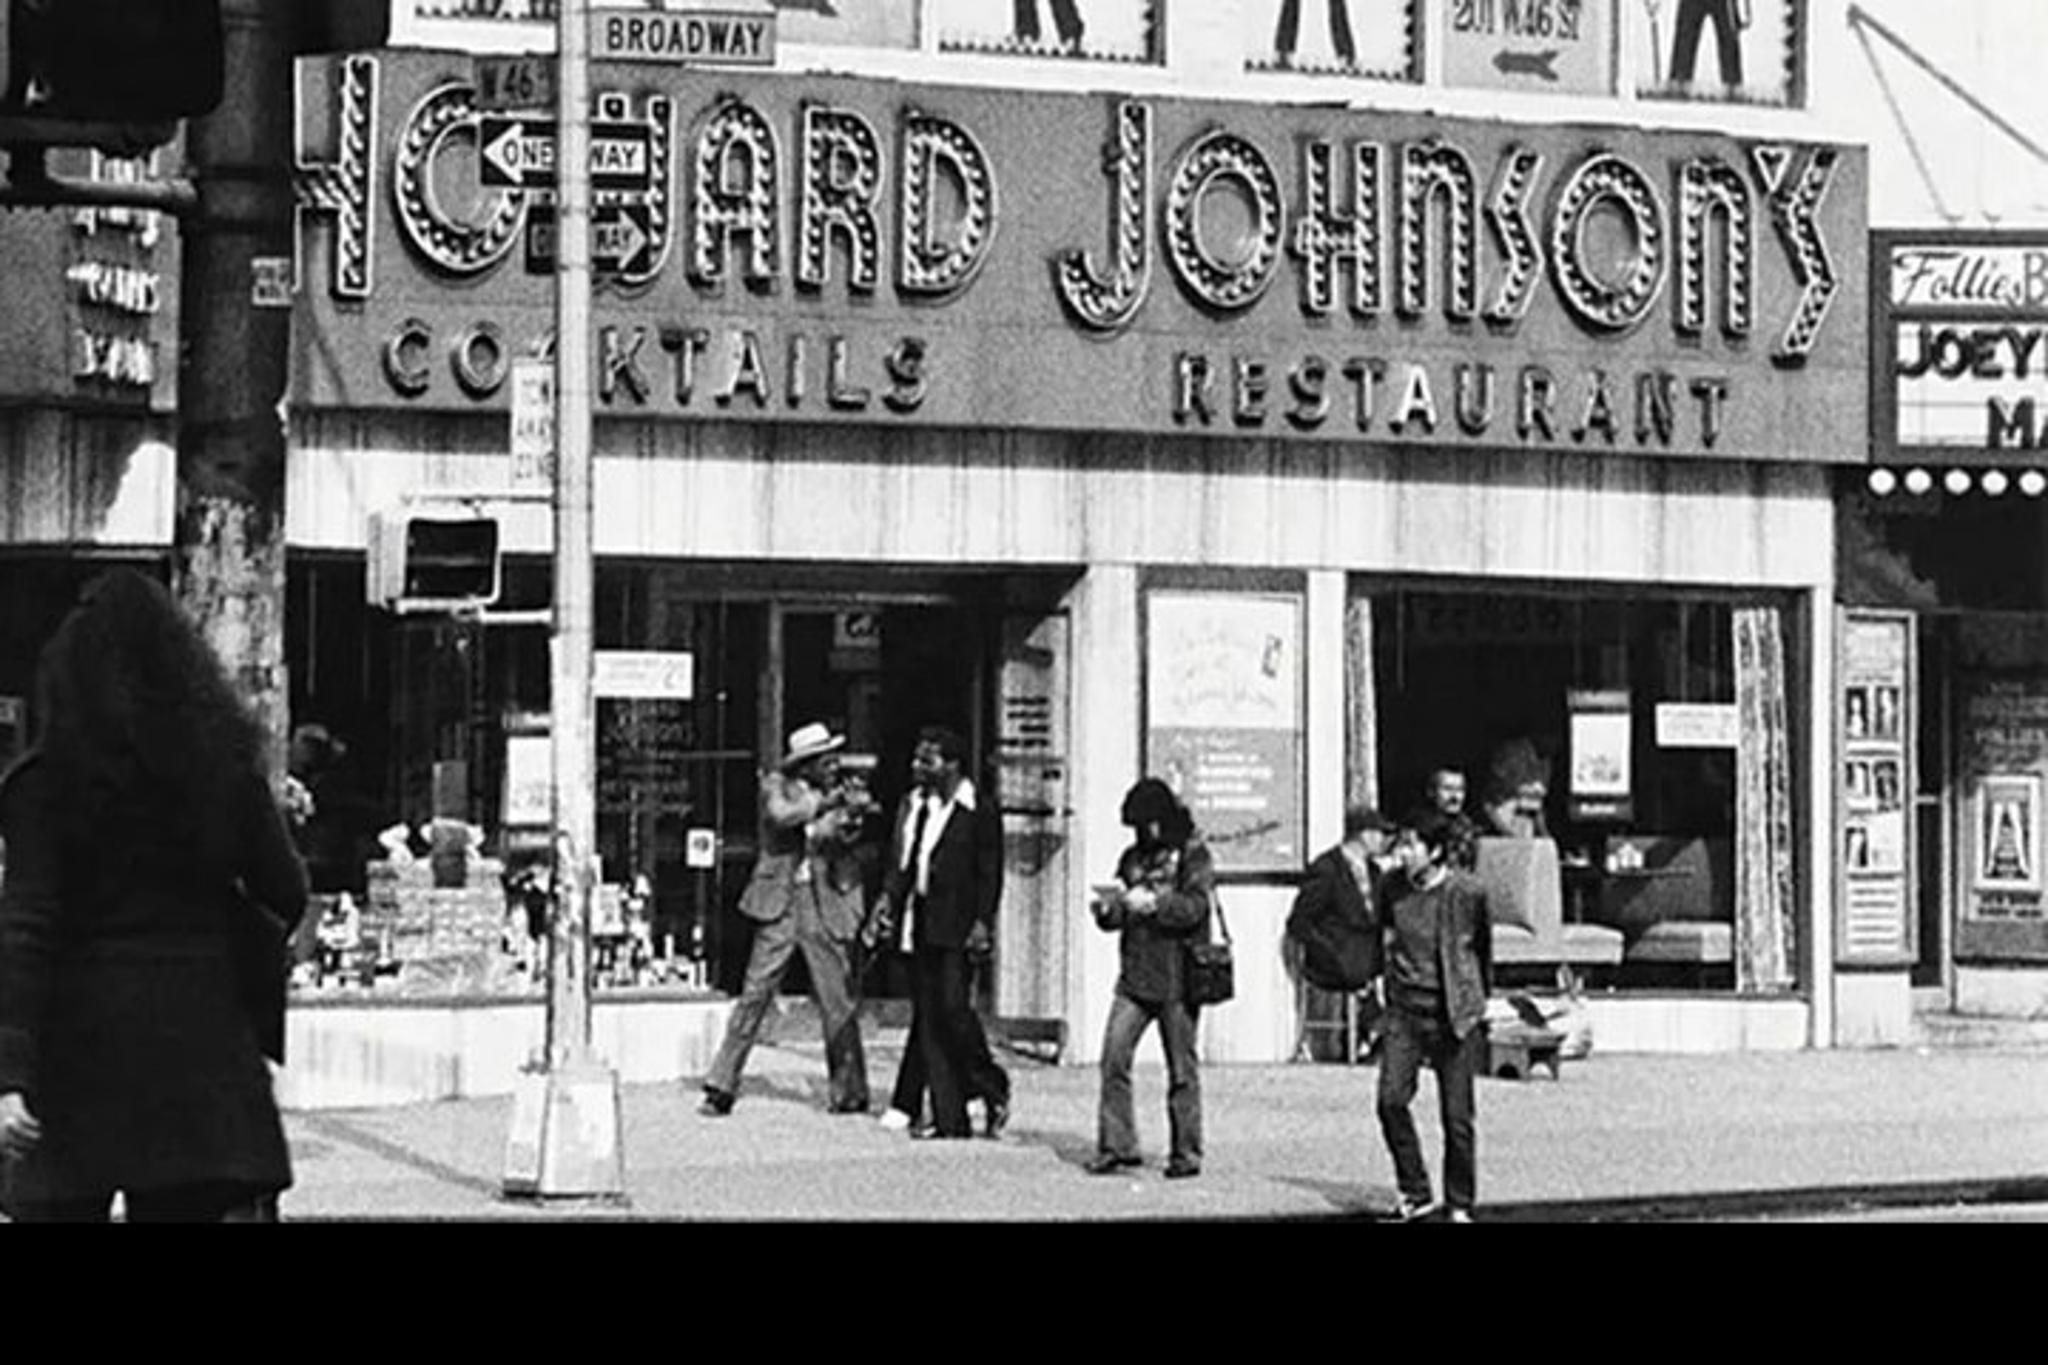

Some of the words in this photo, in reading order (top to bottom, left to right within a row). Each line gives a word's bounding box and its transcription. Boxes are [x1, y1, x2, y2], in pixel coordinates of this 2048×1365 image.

[607, 16, 764, 56] BROADWAY
[503, 139, 554, 168] ONE
[1052, 100, 1838, 362] JOHNSON'S
[1893, 251, 2021, 309] Follies
[383, 319, 928, 412] COKTAILS
[1896, 324, 2042, 380] JOEY
[1173, 350, 1730, 449] RESTAURANT
[1987, 396, 2048, 450] M
